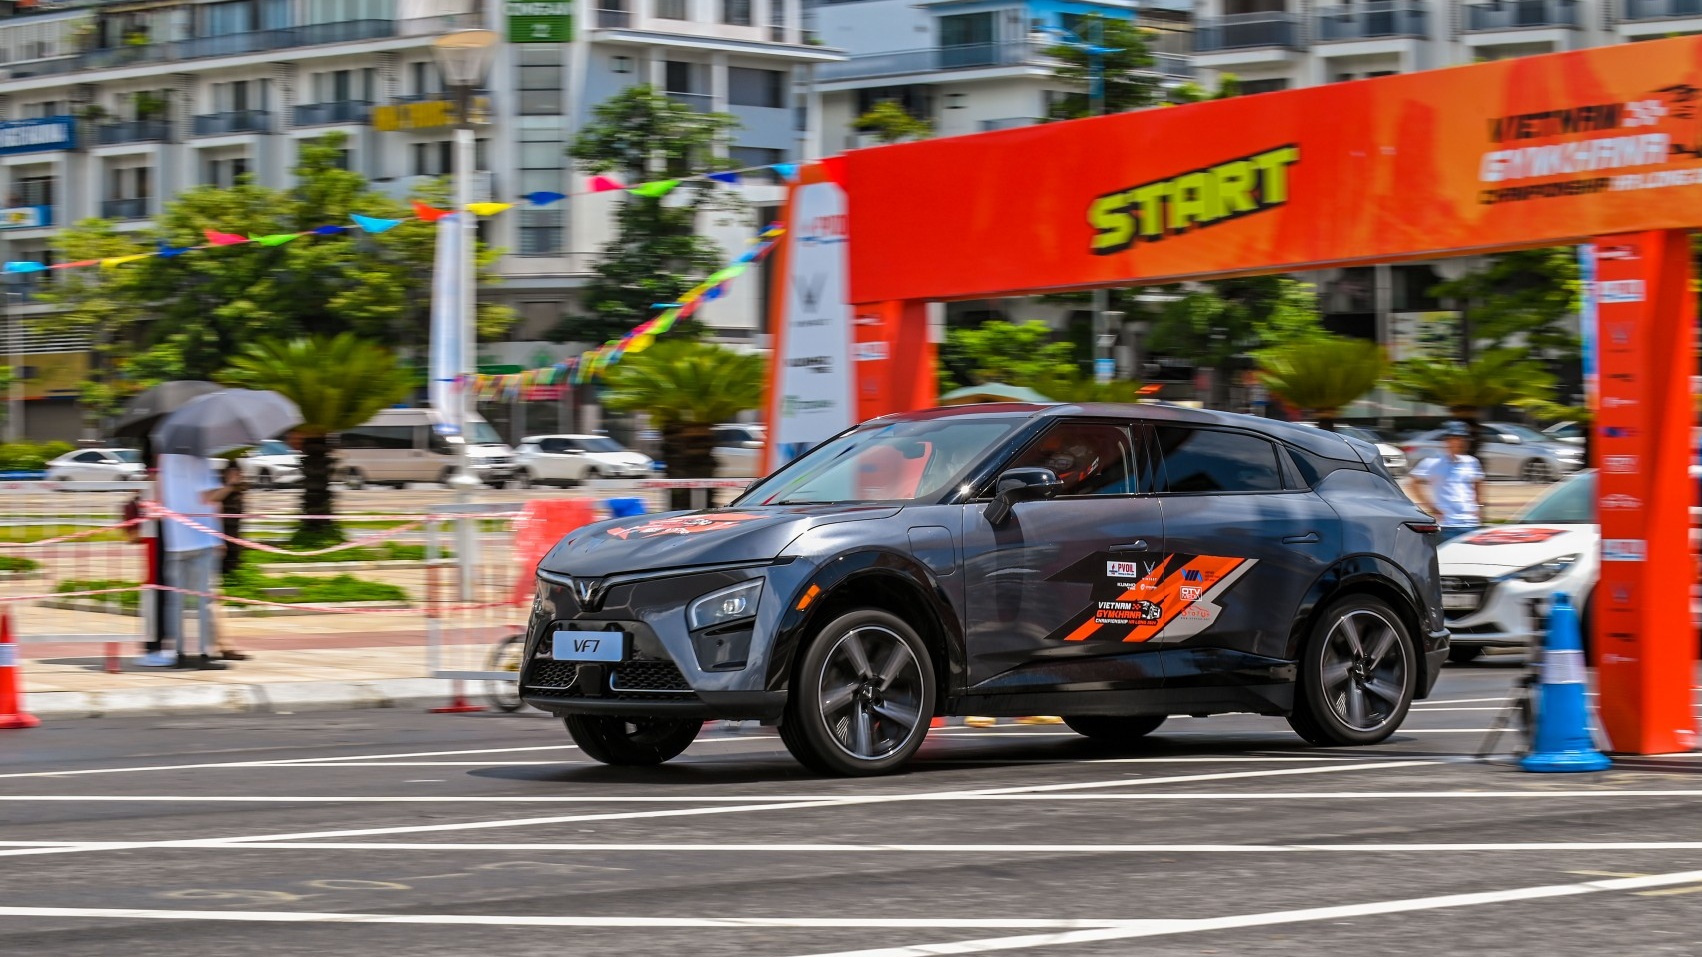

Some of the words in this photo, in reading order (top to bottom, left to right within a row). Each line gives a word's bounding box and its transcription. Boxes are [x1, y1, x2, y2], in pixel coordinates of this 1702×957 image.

[1479, 133, 1669, 182] GYMKHANA
[1087, 144, 1299, 252] START
[1117, 563, 1135, 573] PVOIL
[1098, 601, 1132, 610] VIETNAM
[1096, 610, 1142, 619] GYMKHANA
[574, 639, 601, 653] VF7
